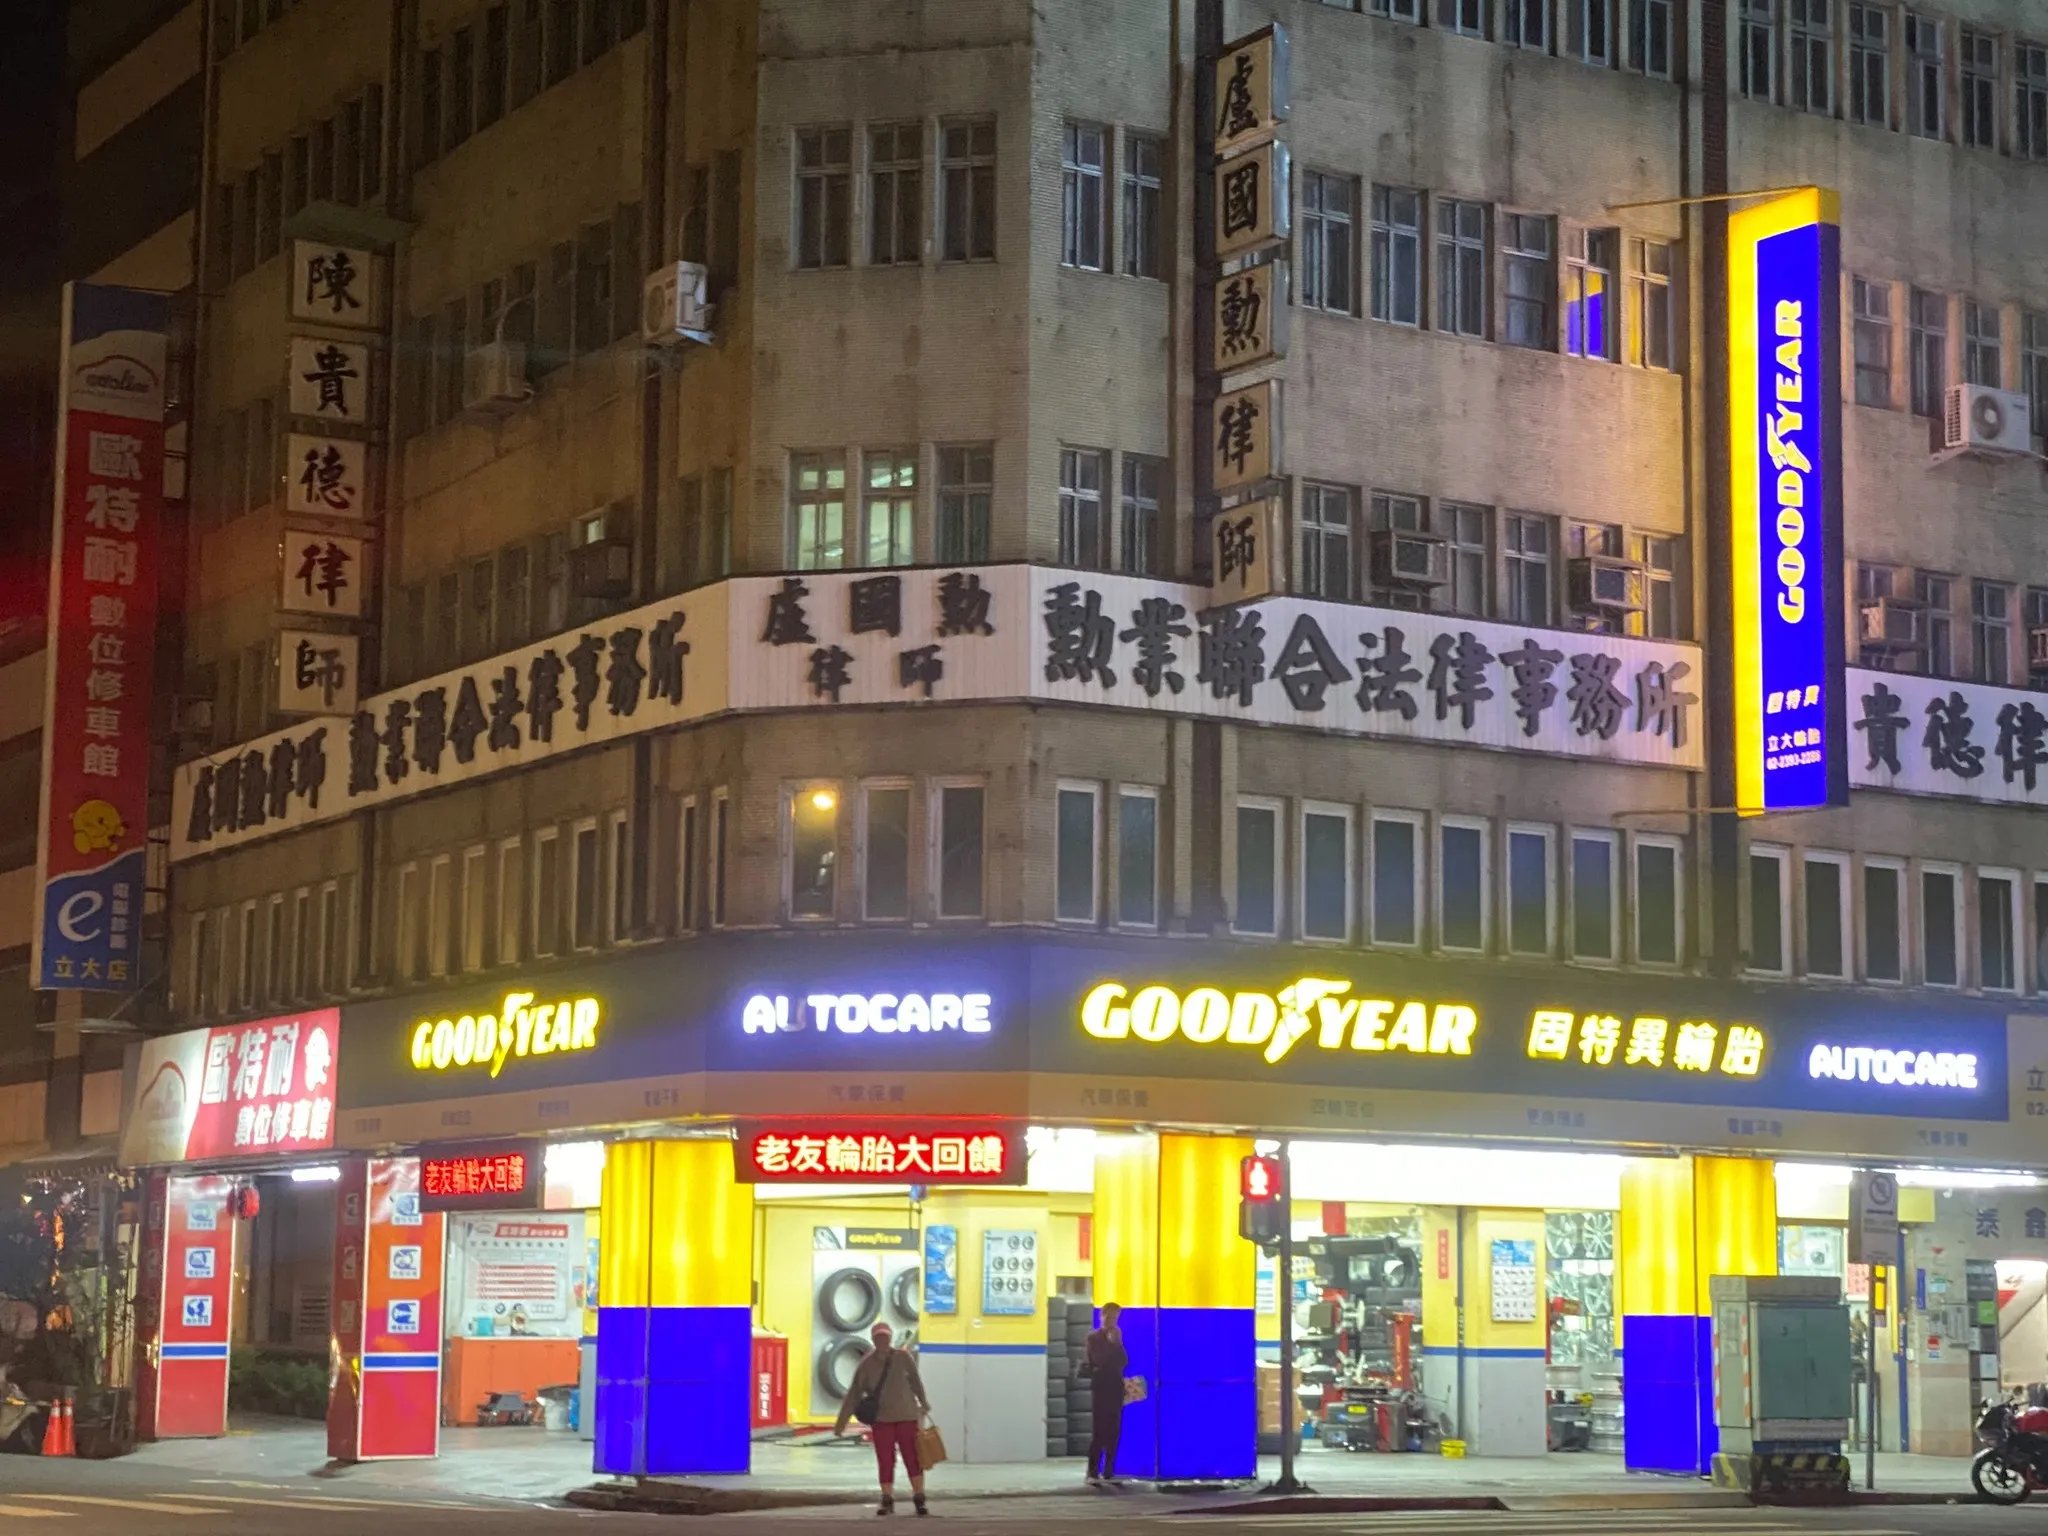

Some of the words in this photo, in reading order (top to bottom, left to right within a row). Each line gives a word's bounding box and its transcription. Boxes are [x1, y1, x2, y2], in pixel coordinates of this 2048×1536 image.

[295, 252, 360, 707] 陳貴德律師
[1767, 299, 1811, 624] GOODYEAR
[807, 644, 943, 702] 律師
[1854, 683, 2048, 791] 貴德律
[53, 955, 129, 982] 立大店
[411, 993, 600, 1077] GOODYEAR
[742, 993, 992, 1034] AUTOCARE
[1081, 978, 1478, 1064] GOODYEAR
[1527, 1009, 1765, 1076] 固特異輪胎
[202, 1021, 299, 1104] 歐特耐
[1809, 1044, 1977, 1088] AUTOCARE
[2026, 1065, 2046, 1091] 立
[234, 1096, 332, 1146] 數位修車館
[425, 1155, 525, 1195] 老友輪胎大回饋
[755, 1135, 1003, 1174] 老友輪胎大回饋
